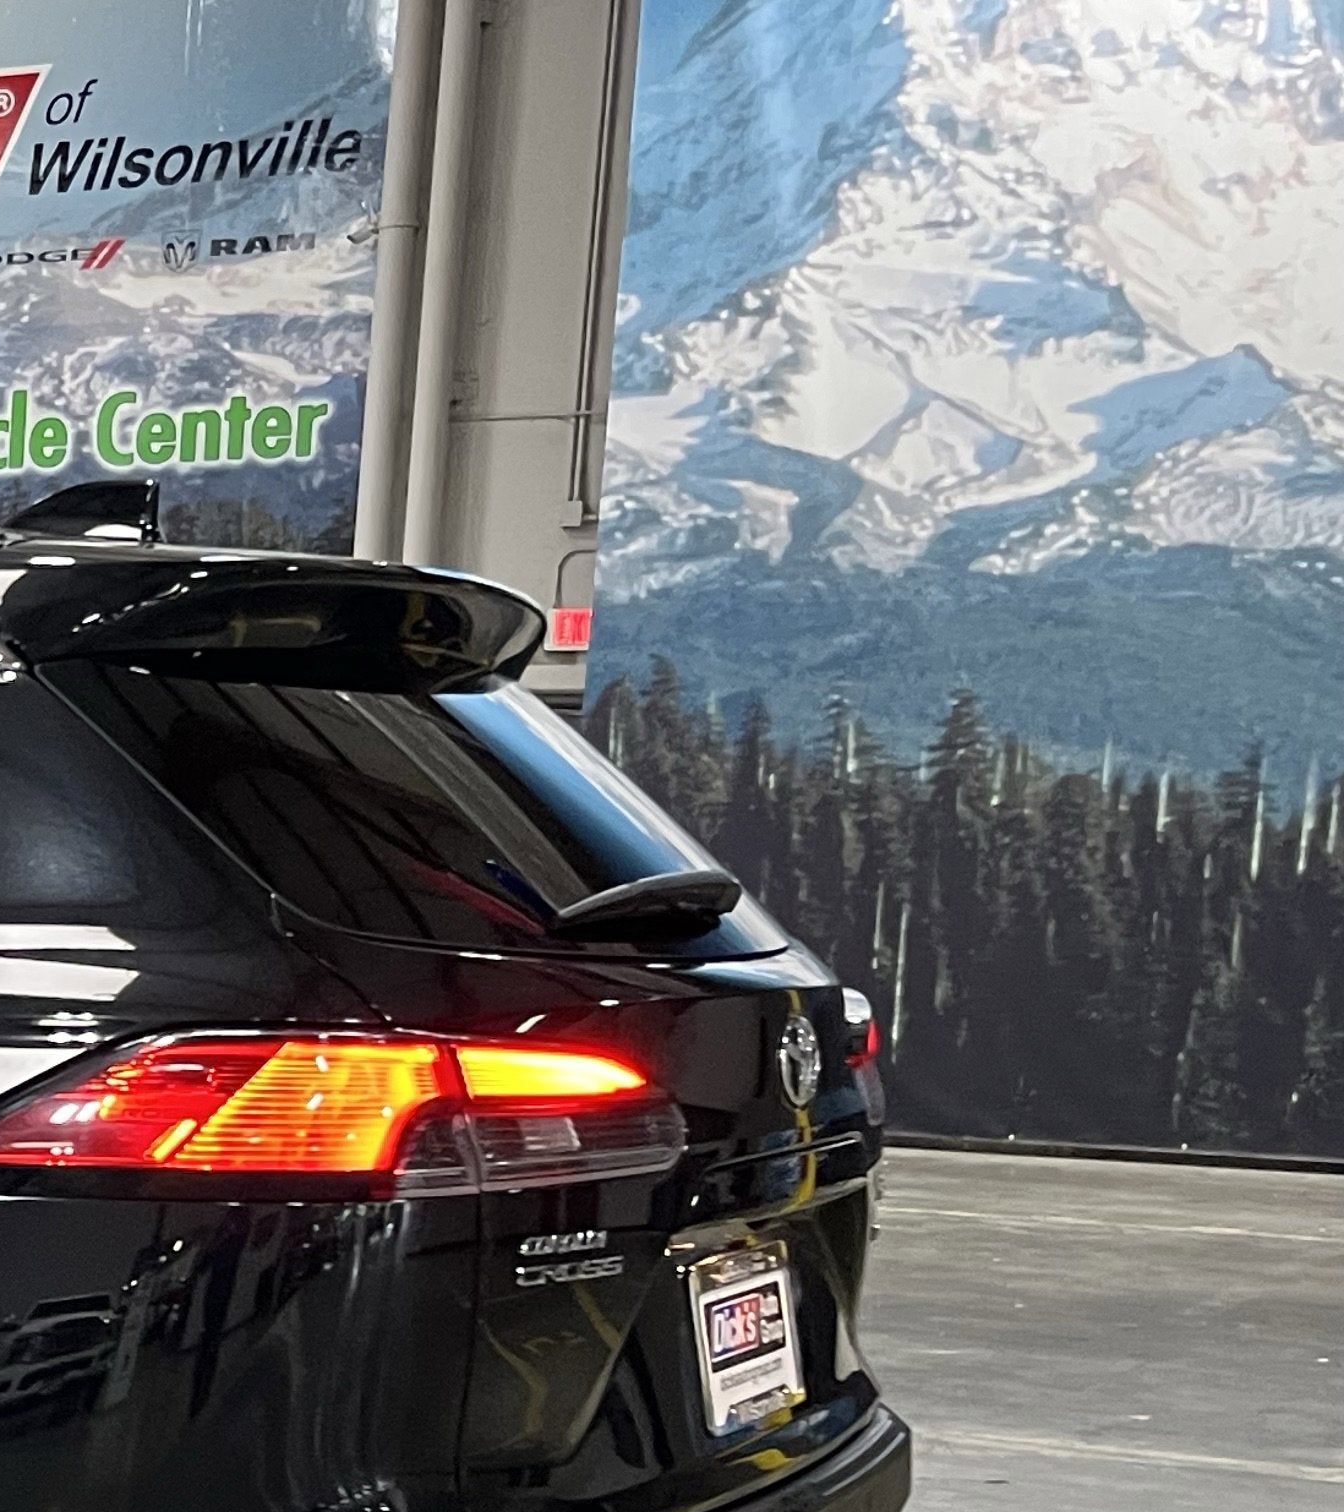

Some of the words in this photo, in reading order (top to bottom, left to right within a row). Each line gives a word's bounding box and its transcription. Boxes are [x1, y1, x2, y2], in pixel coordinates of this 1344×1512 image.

[44, 79, 99, 127] of
[26, 120, 363, 197] Wilsonville
[210, 233, 317, 257] RAM
[95, 390, 330, 468] Center
